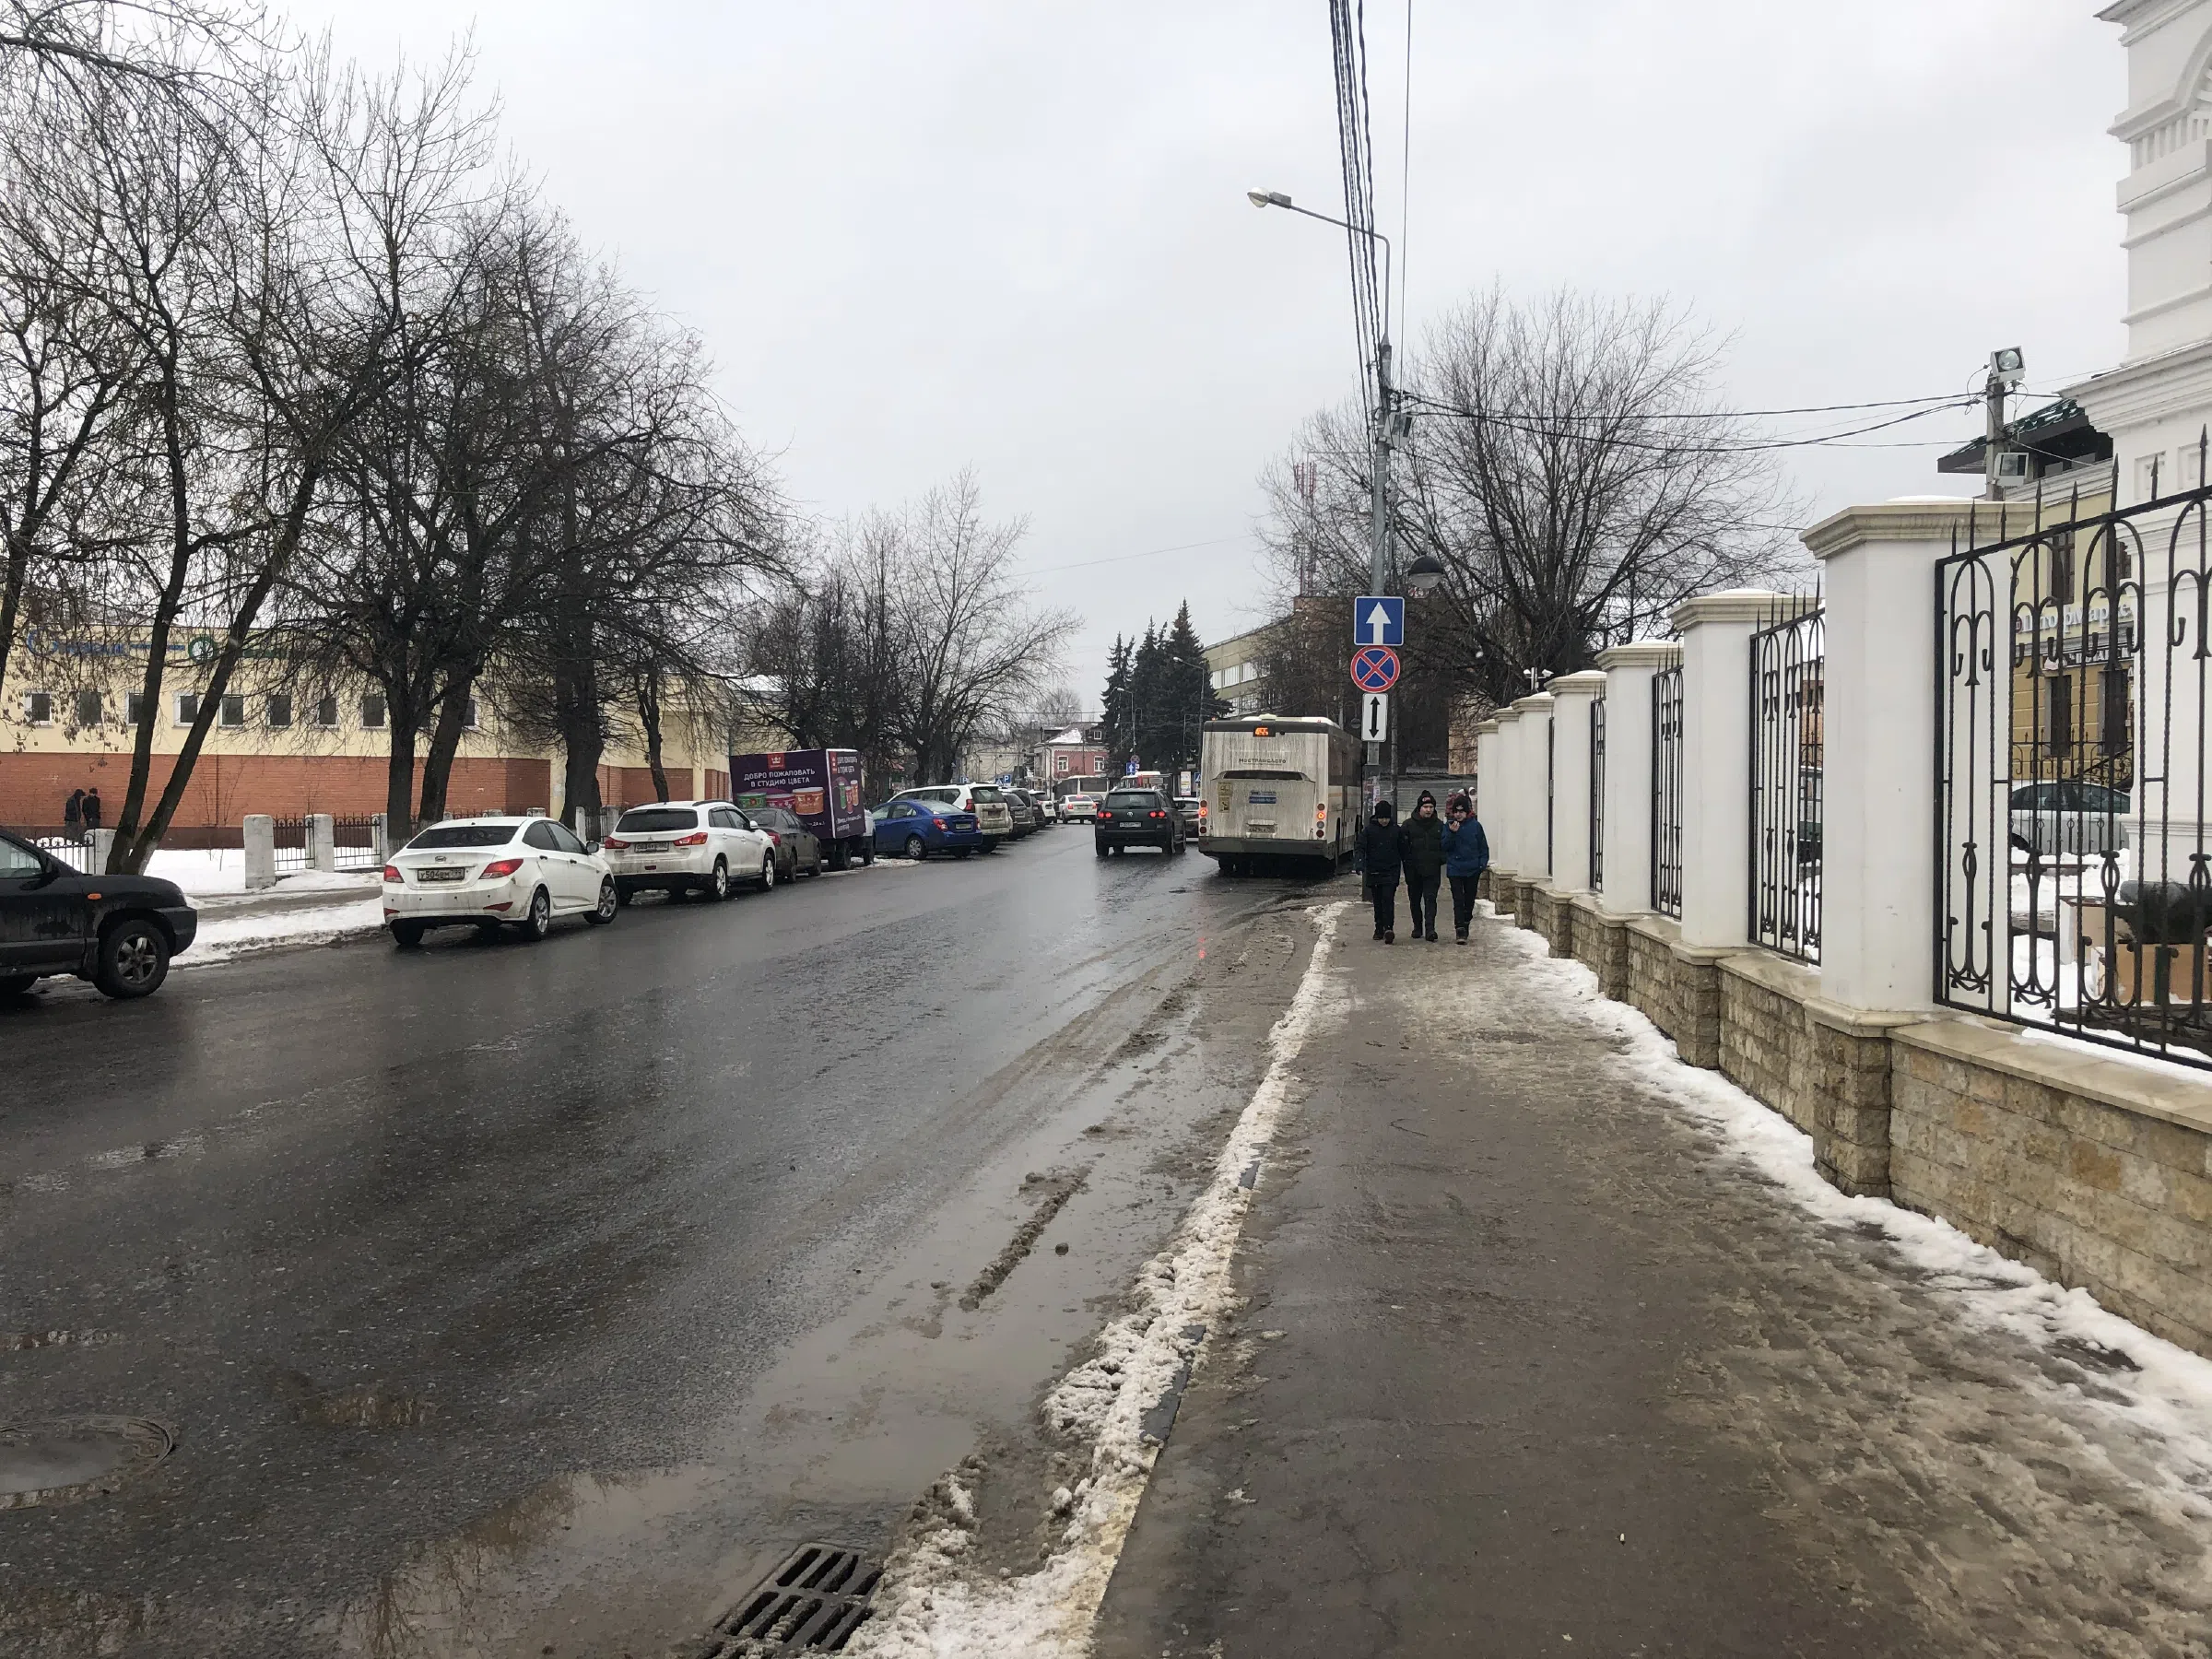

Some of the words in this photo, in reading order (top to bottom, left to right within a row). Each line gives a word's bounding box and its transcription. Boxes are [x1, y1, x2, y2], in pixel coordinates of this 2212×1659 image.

[744, 771, 767, 781] ДОБРО
[769, 769, 816, 778] ПОЖАЛОВАТЬ
[758, 779, 786, 787] СТУДИЮ
[788, 777, 810, 785] ЦВЕТА
